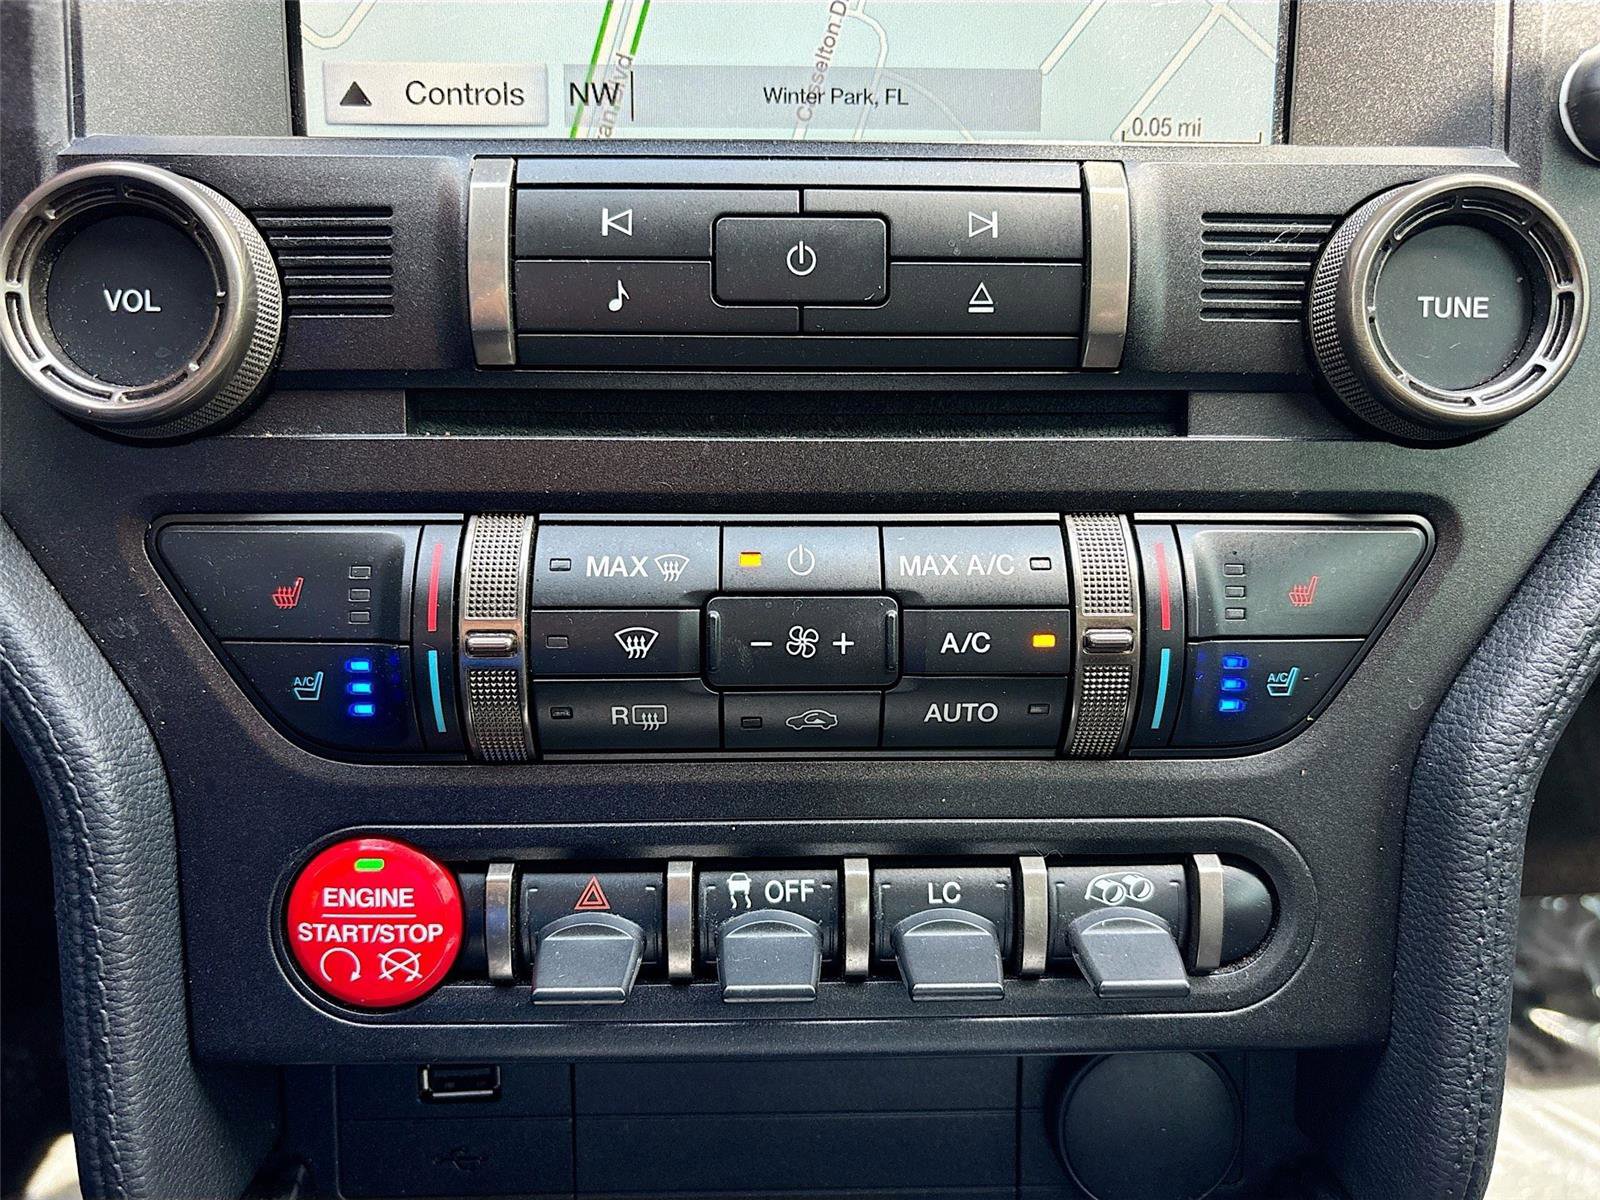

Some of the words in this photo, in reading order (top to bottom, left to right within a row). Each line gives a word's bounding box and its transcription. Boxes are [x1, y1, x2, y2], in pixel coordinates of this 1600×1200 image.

[796, 22, 841, 122] Csselton
[405, 80, 525, 107] Controls
[569, 82, 620, 106] NW
[763, 86, 826, 105] Winter
[831, 87, 879, 108] Park,
[885, 88, 909, 106] FL
[1132, 117, 1172, 136] 0.05
[1178, 117, 1202, 136] mi
[103, 288, 161, 313] VOL
[1418, 296, 1489, 319] TUNE
[585, 555, 648, 577] MAX
[899, 555, 960, 576] MAX
[966, 554, 1015, 576] A/C
[940, 631, 991, 654] A/C
[293, 676, 315, 687] A/C
[1267, 672, 1288, 682] A/C
[611, 707, 629, 725] R
[923, 702, 999, 723] AUTO
[322, 886, 415, 909] ENGINE
[764, 879, 816, 903] OFF
[927, 881, 962, 905] LC
[297, 921, 444, 944] START/STOP
